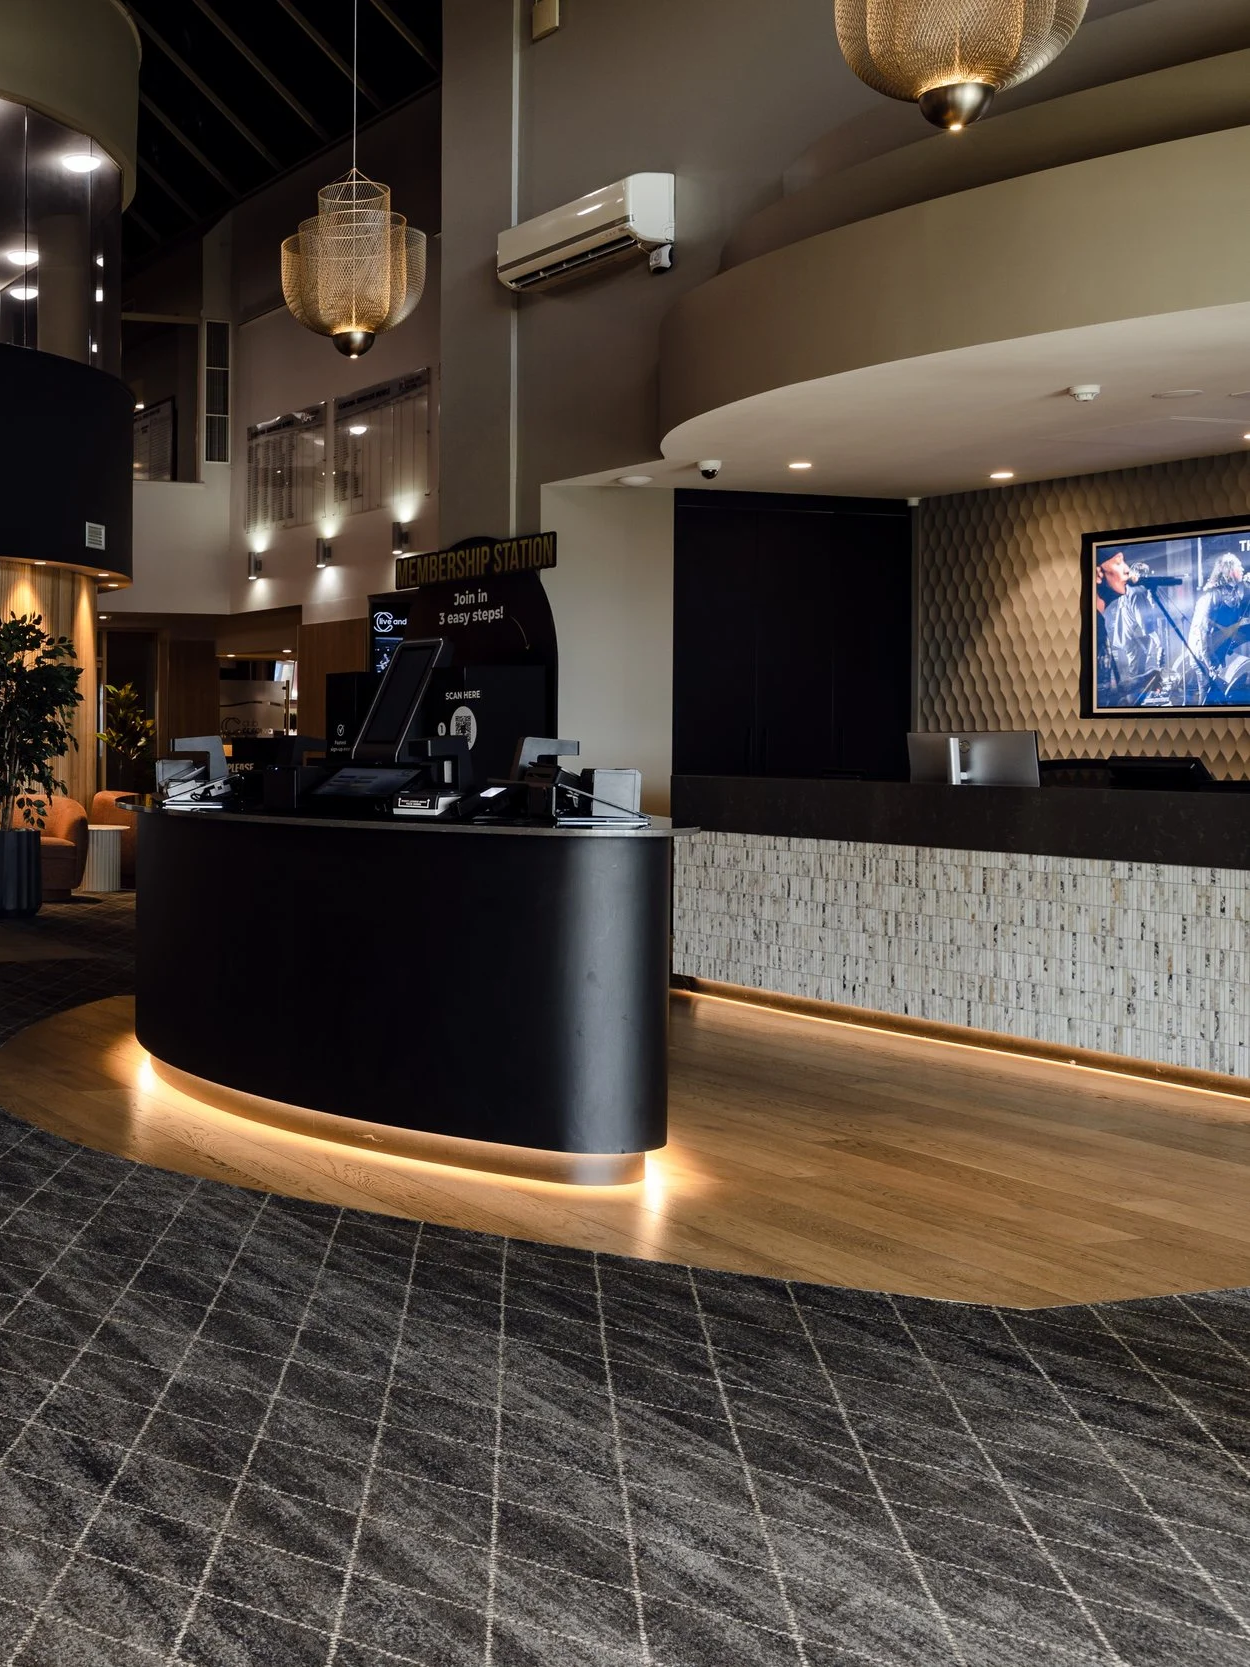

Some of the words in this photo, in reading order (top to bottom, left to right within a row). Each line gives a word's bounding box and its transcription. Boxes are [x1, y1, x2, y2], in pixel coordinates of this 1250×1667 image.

[396, 546, 490, 587] MEMBERSHIP
[493, 534, 554, 573] STATION
[454, 590, 475, 606] Join
[478, 588, 488, 603] in
[393, 617, 407, 625] and
[439, 612, 445, 625] 3
[447, 611, 471, 625] easy
[472, 606, 504, 624] steps!
[445, 691, 463, 700] SCAN
[463, 690, 481, 699] HERE
